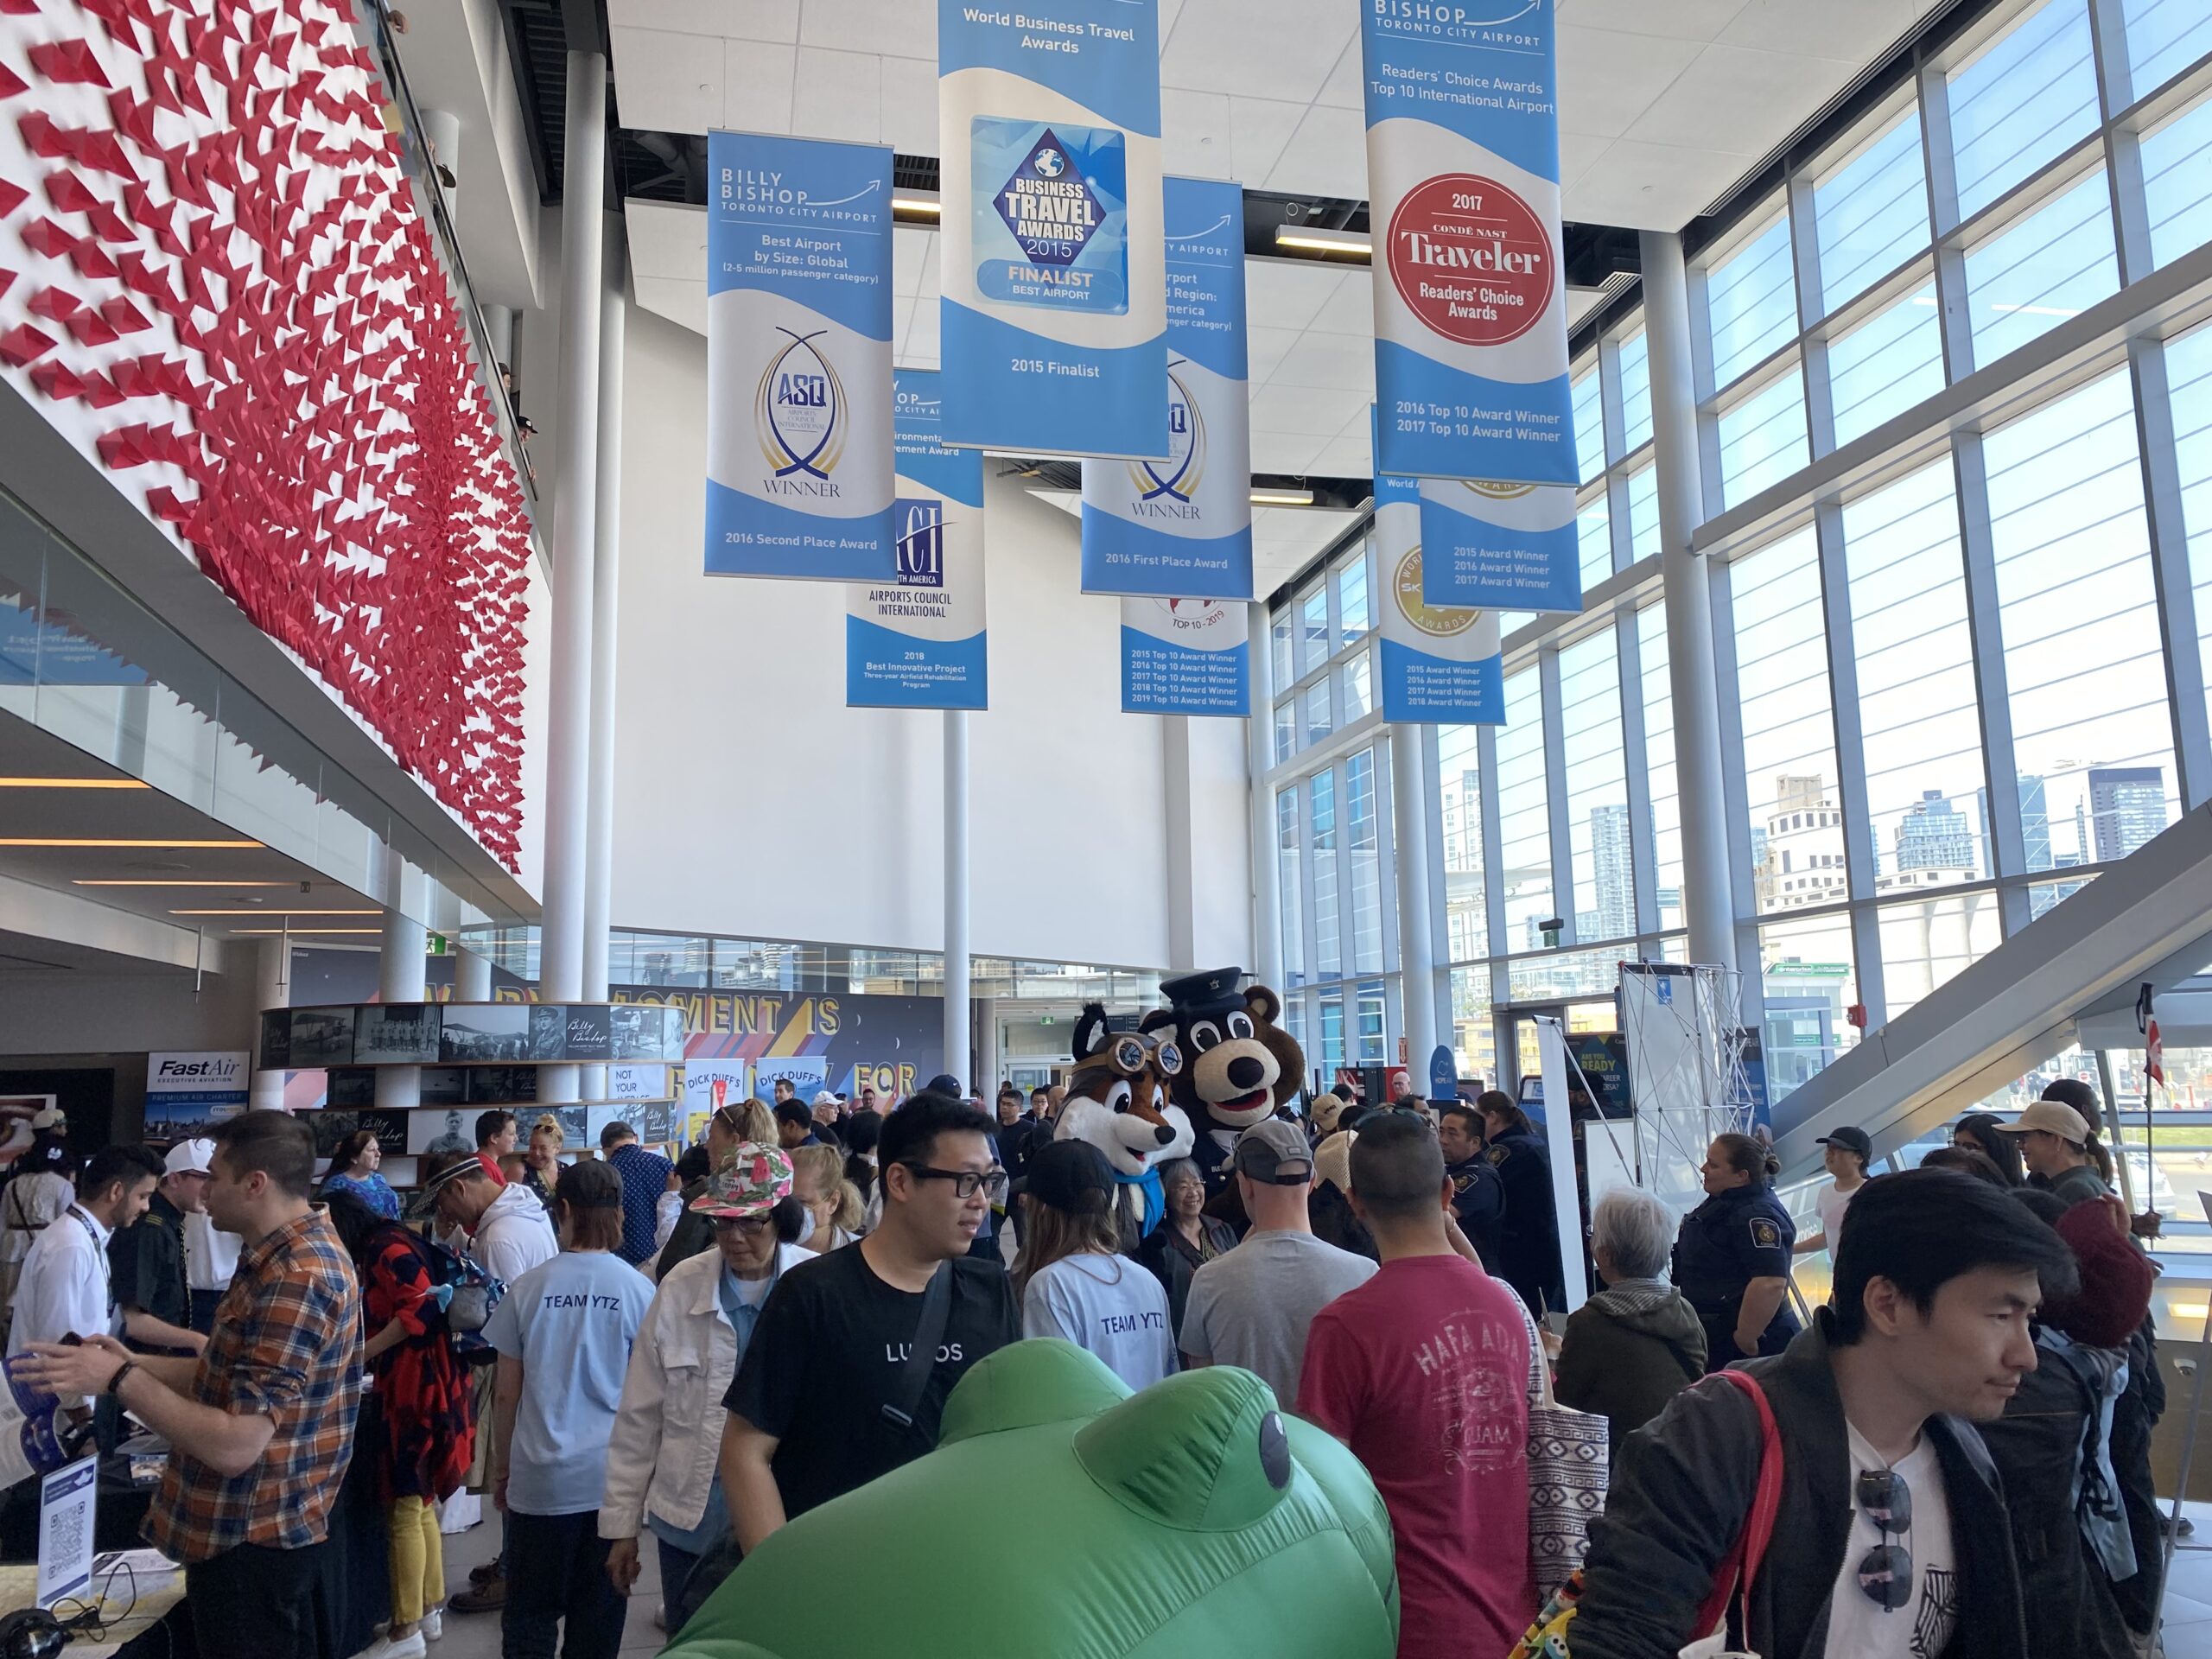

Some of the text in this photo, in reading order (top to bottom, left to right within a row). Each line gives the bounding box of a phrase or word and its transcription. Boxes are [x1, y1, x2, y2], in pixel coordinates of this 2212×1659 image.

[1375, 0, 1465, 24] BISHOP
[963, 8, 1135, 41] World Business Travel
[1376, 18, 1540, 46] TORONTO CITY AIRPORT
[1021, 35, 1078, 53] Awards
[1382, 64, 1542, 94] Readers' Choice Awards
[1371, 81, 1554, 114] Top 10 International Airport
[721, 168, 781, 186] BILLY
[721, 185, 807, 204] BISHOP
[1016, 178, 1084, 199] BUSINESS
[1005, 193, 1095, 226] TRAVEL
[1452, 194, 1482, 210] 2017
[721, 202, 877, 223] TORONTO CITY AIRPORT
[1017, 221, 1084, 241] AWARDS
[1477, 229, 1507, 238] NAST
[762, 235, 841, 251] Best Airport
[1027, 239, 1072, 257] 2015
[1179, 245, 1228, 256] AIRPORT
[754, 251, 849, 269] by Size: Global
[1401, 232, 1541, 274] Traveler
[723, 263, 878, 284] (2-5 million passenger category)
[1009, 266, 1093, 287] FINALIST
[1166, 274, 1197, 284] rport
[1013, 286, 1090, 300] BEST AIRPORT
[1174, 288, 1217, 302] Region:
[1420, 282, 1524, 306] Readers' Choice
[1166, 304, 1205, 315] merica
[1448, 302, 1497, 321] Awards
[1192, 320, 1231, 331] category)
[1011, 359, 1100, 378] 2015 Finalist
[778, 373, 826, 407] ASQ
[1396, 401, 1560, 424] 2016 Top 10 Award Winner
[1397, 420, 1560, 442] 2017 Top 10 Award Winner
[929, 447, 959, 455] Award
[764, 480, 841, 498] WINNER
[1387, 479, 1413, 488] World
[1132, 503, 1200, 519] WINNER
[725, 532, 877, 550] 2016 Second Place Award
[1106, 554, 1228, 569] 2016 First Place Award
[1454, 547, 1549, 561] 2015 Award Winner
[1454, 562, 1549, 575] 2016 Award Winner
[909, 575, 937, 584] AMERICA
[1455, 575, 1551, 589] 2017 Award Winner
[869, 590, 951, 604] AIRPORTS COUNCIL
[879, 604, 946, 618] INTERNATIONAL
[1173, 619, 1190, 629] TOP
[1206, 610, 1224, 626] 2019
[1153, 651, 1166, 659] Top
[888, 664, 932, 672] Innovative
[935, 664, 965, 673] Project
[1153, 662, 1166, 671] Top
[1153, 673, 1166, 682] Top
[1427, 677, 1451, 685] Award
[1153, 684, 1166, 693] Top
[1209, 687, 1237, 696] Winner
[1154, 696, 1166, 704] Top
[1209, 698, 1237, 707] Winner
[807, 997, 841, 1036] IS
[616, 1071, 632, 1079] NOT
[688, 1073, 709, 1089] DICK
[760, 1071, 785, 1086] DICK
[854, 1062, 918, 1100] FOR
[616, 1083, 637, 1092] YOUR
[543, 1294, 620, 1311] TEAM YTZ
[1101, 1312, 1164, 1335] TEAM YTZ
